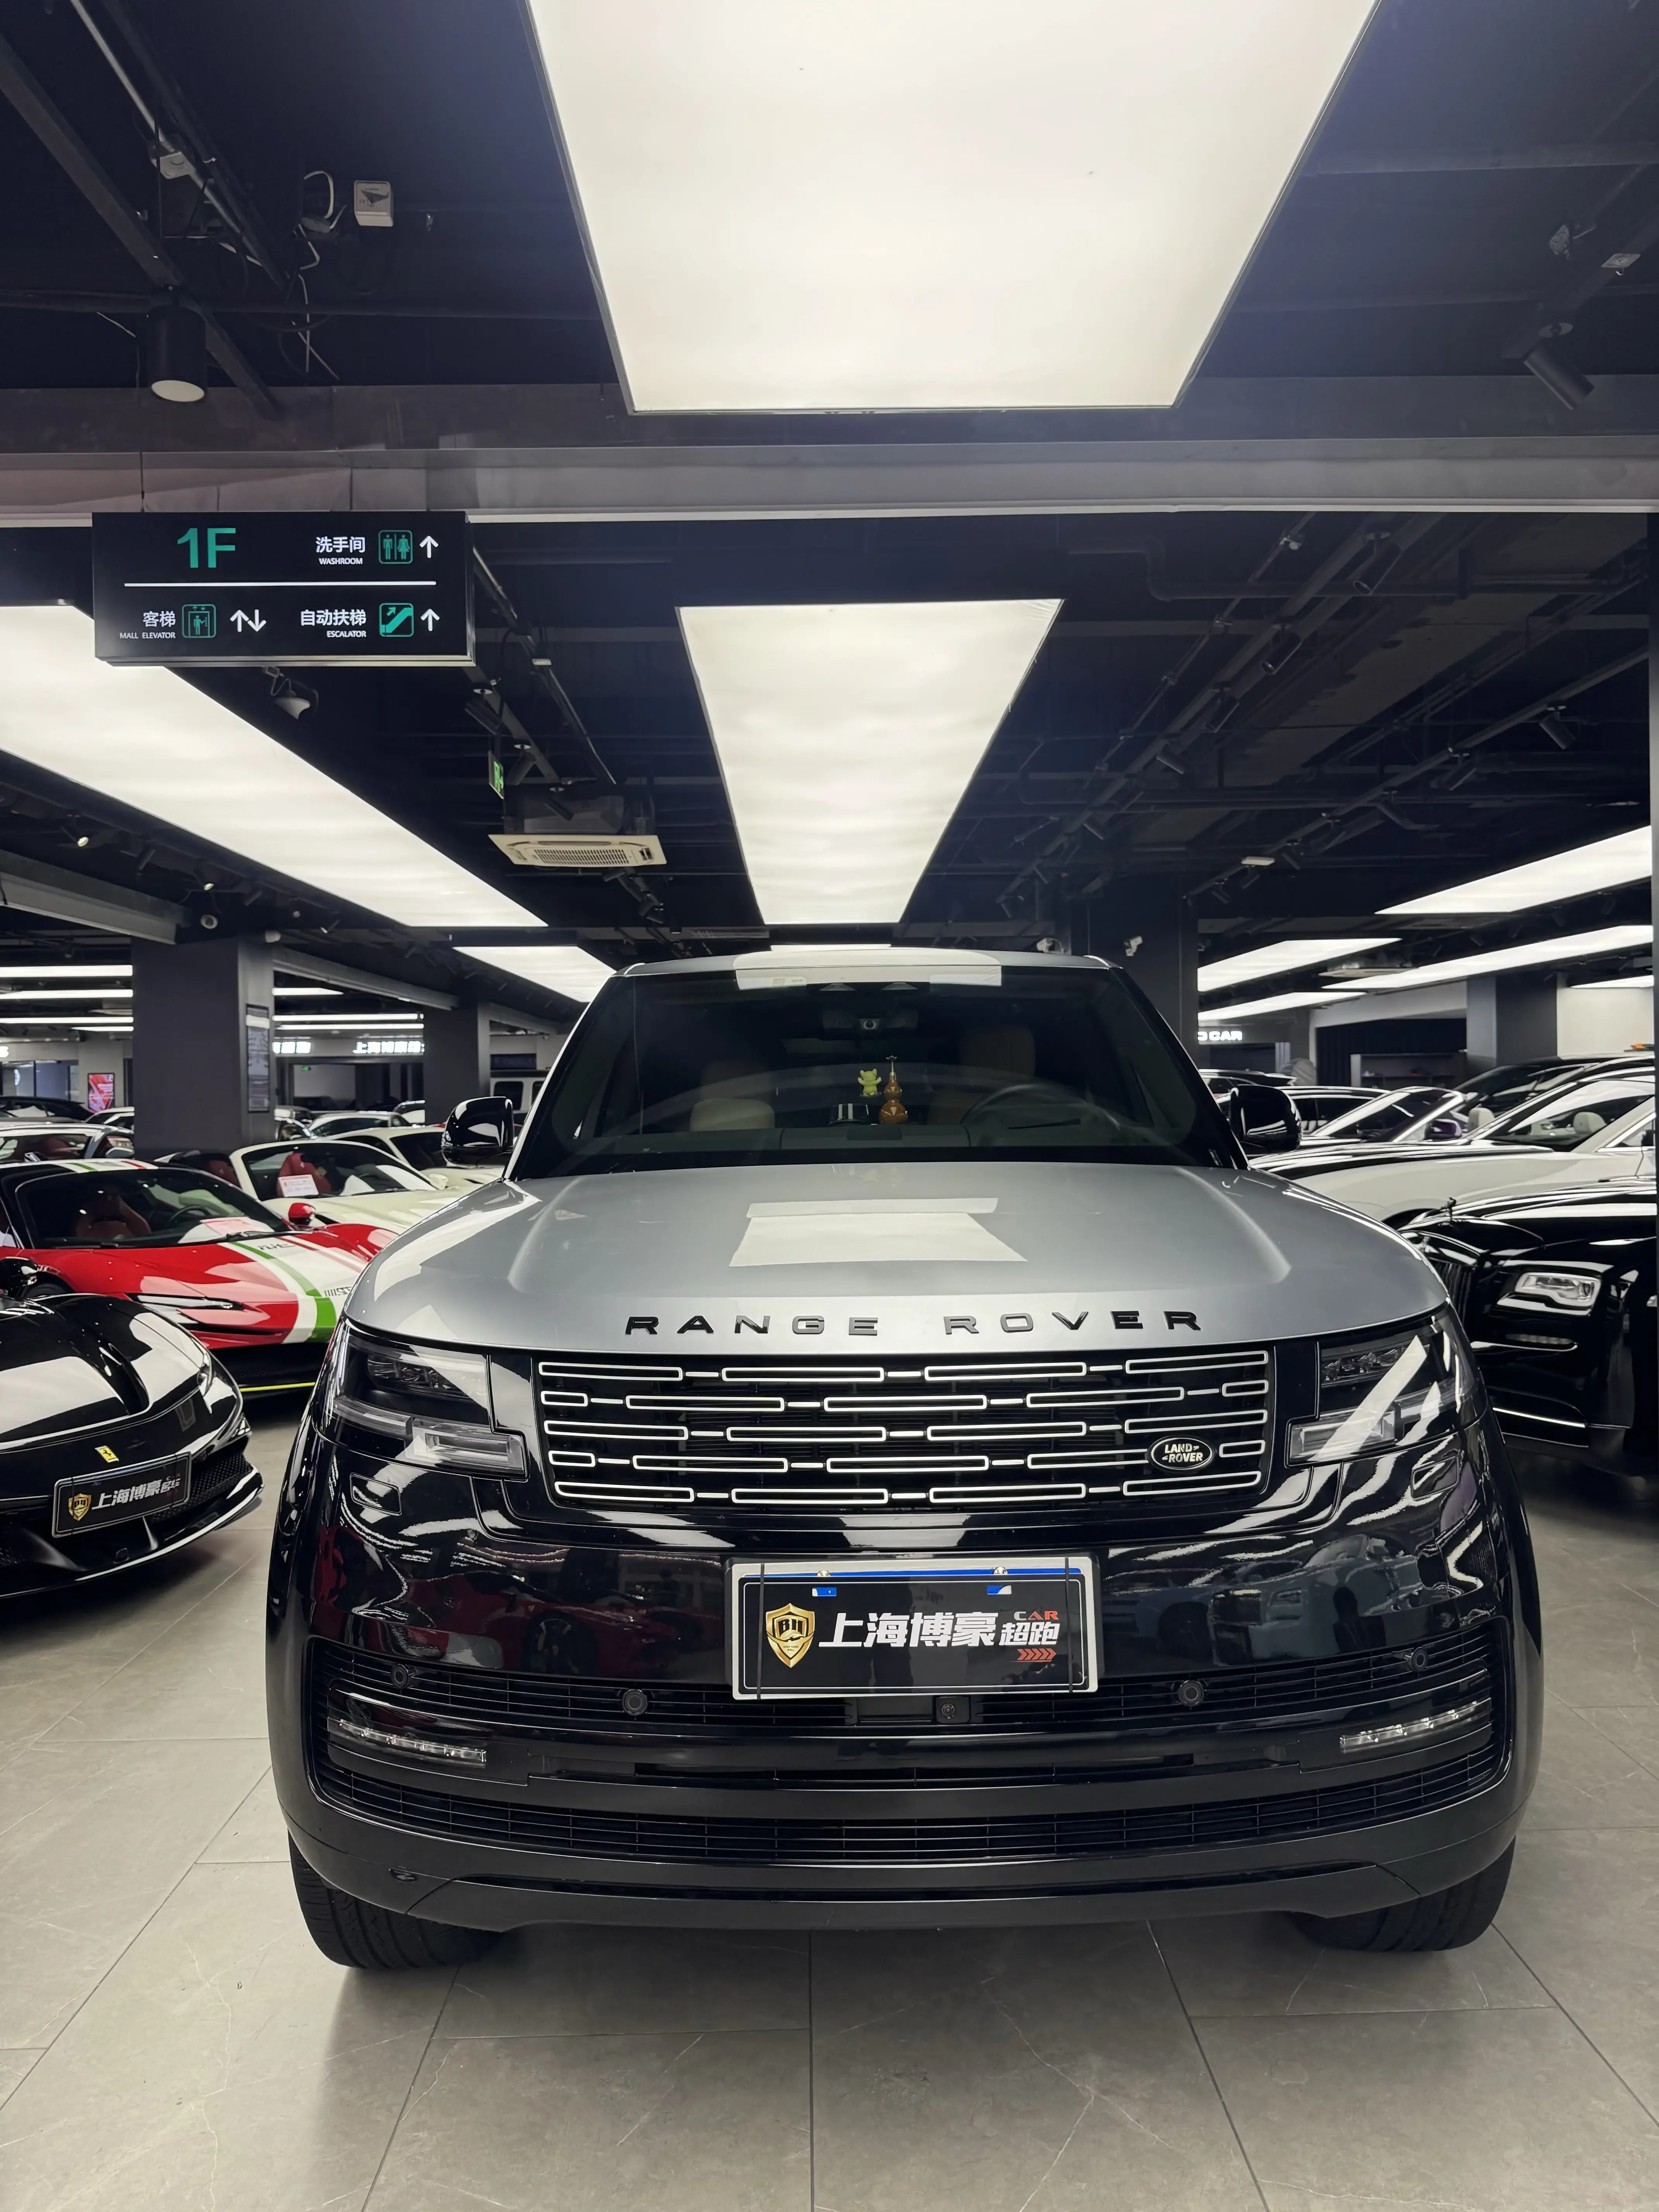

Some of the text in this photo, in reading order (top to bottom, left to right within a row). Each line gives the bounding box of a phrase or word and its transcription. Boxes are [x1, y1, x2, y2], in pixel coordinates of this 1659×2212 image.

[177, 527, 236, 568] 1F
[315, 536, 366, 553] 洗手间
[142, 611, 176, 627] 客梯
[300, 609, 367, 627] 自动扶梯
[625, 1310, 1202, 1337] RANGE ROVER
[1164, 1443, 1192, 1454] LAND
[1168, 1452, 1203, 1463] ROVER
[1013, 1611, 1060, 1621] CAR
